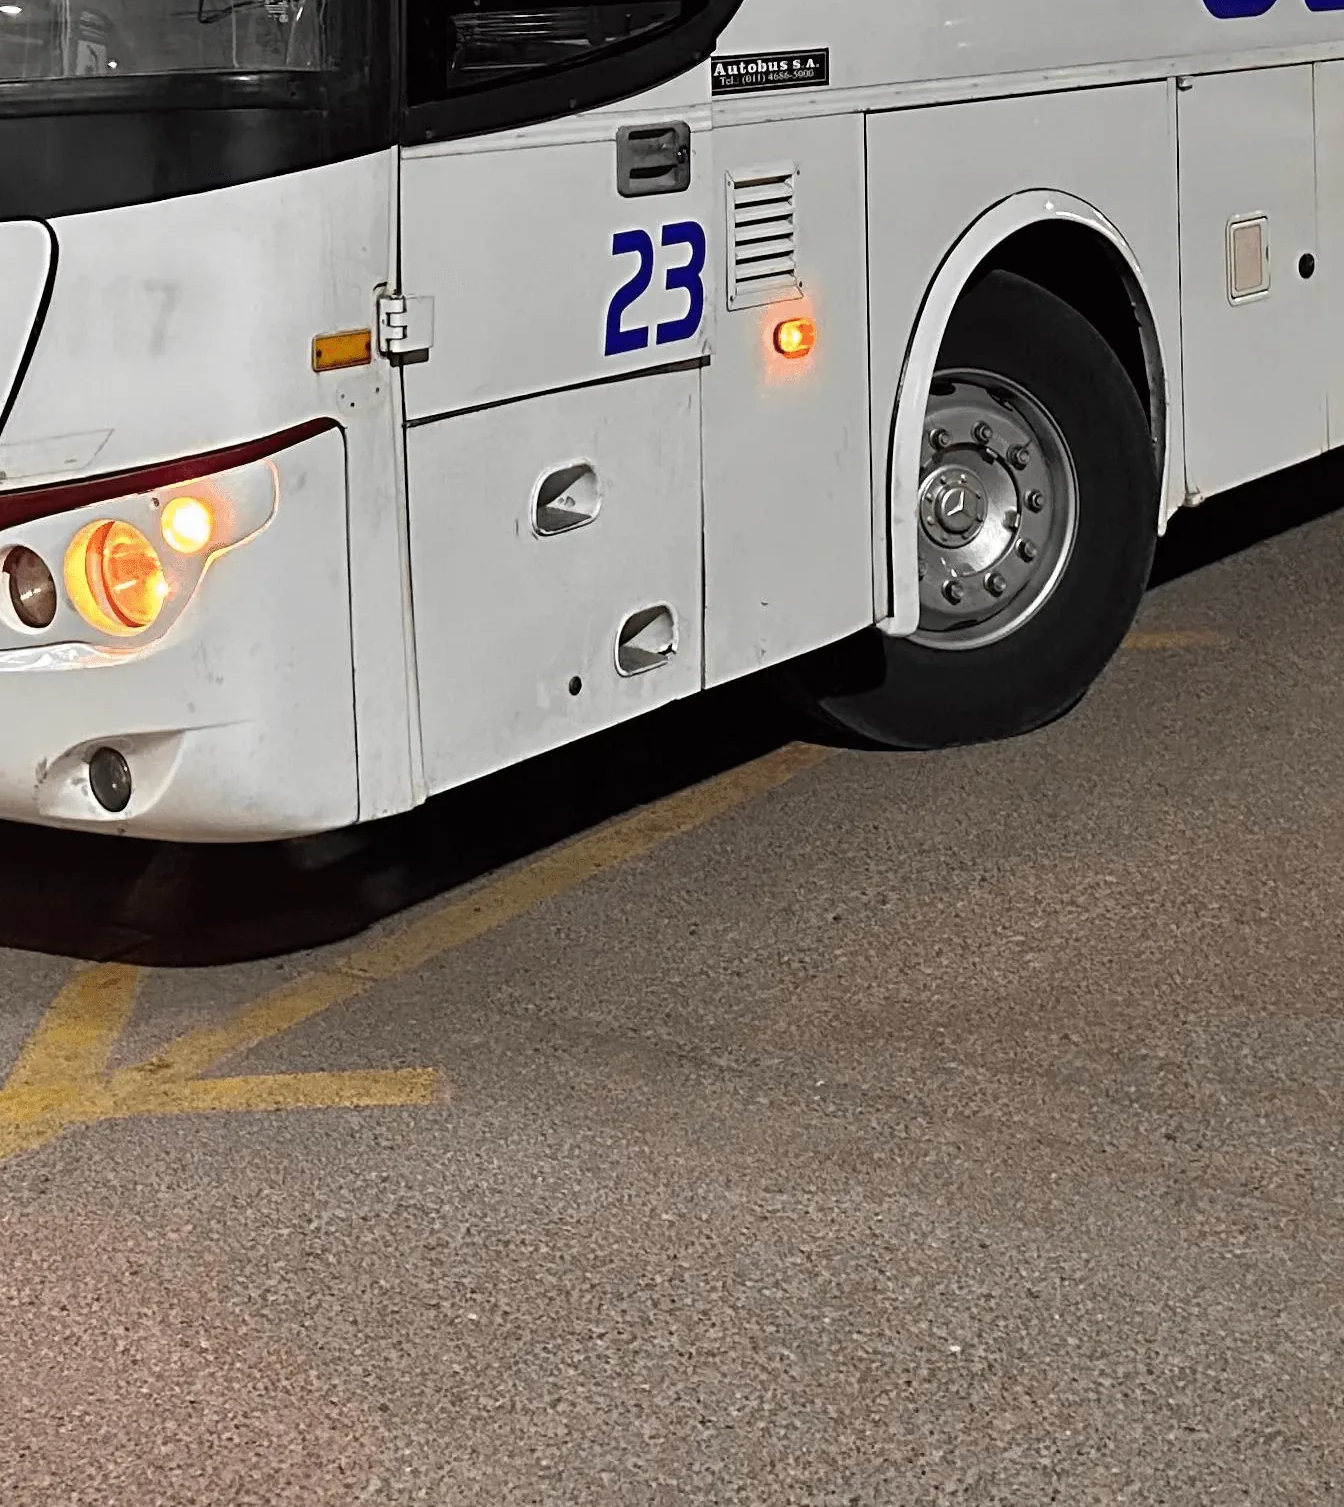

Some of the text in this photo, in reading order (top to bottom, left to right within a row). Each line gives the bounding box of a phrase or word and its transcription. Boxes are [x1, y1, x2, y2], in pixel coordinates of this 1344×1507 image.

[713, 59, 788, 76] Autobus
[742, 73, 766, 85] (011)
[604, 220, 706, 357] 23
